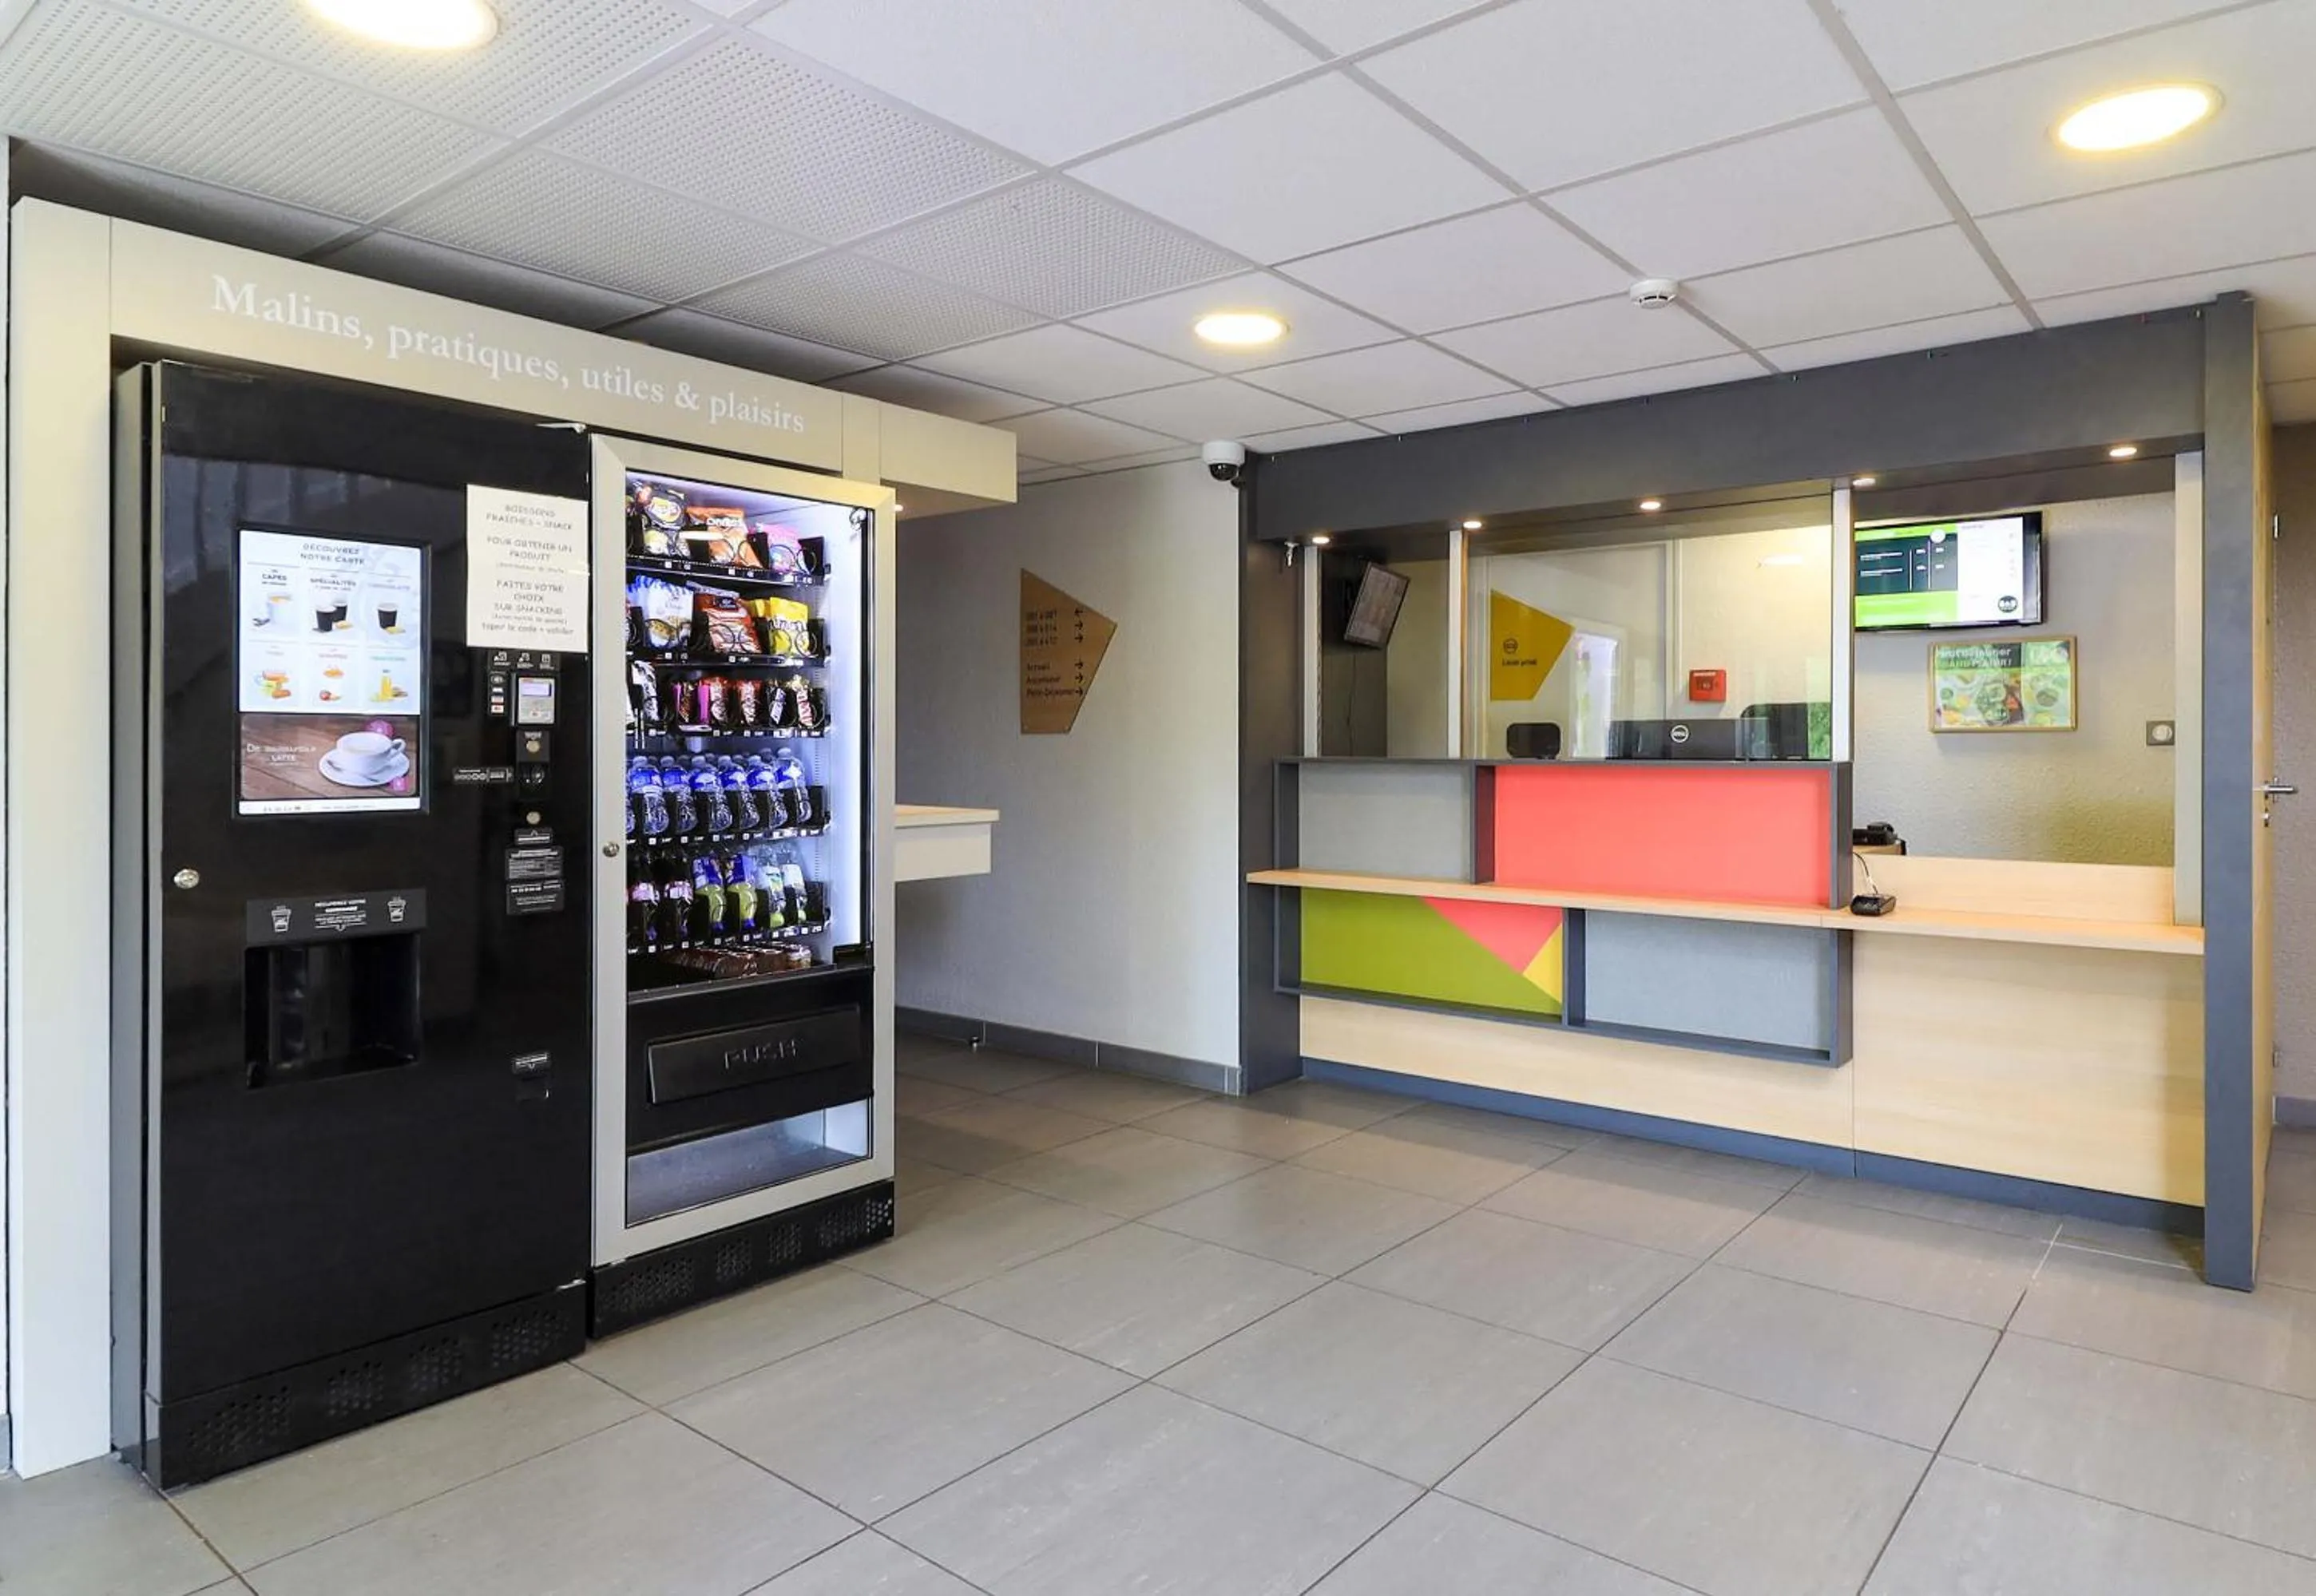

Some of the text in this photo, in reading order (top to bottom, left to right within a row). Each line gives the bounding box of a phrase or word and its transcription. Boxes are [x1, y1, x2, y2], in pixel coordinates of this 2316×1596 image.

[210, 275, 805, 434] Malins, pratiques, utiles & plaisirs
